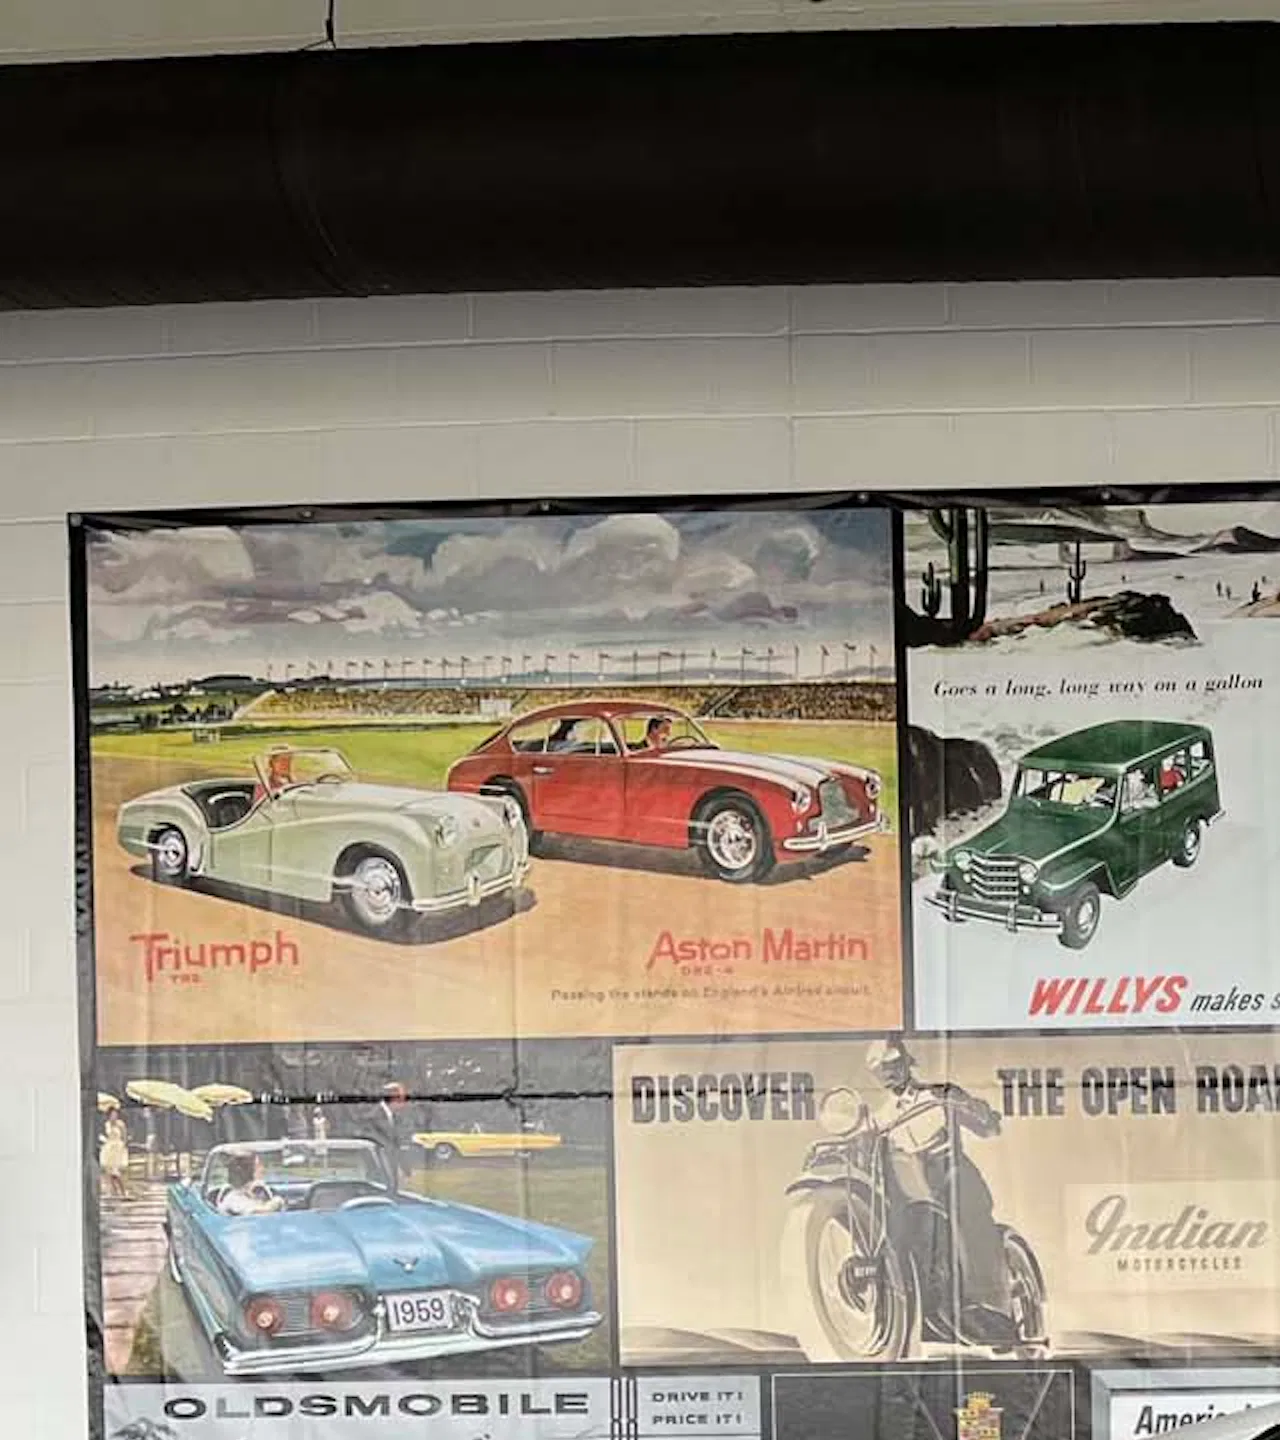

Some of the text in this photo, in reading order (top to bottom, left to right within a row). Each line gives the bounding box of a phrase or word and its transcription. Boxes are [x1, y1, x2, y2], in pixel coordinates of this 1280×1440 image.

[934, 680, 977, 698] Goes
[985, 684, 997, 696] a
[1059, 679, 1100, 698] long
[1154, 681, 1177, 692] on
[1185, 681, 1197, 691] a
[1204, 673, 1264, 692] gallon
[129, 930, 299, 983] Triumph
[645, 927, 869, 970] Aston Martin
[1028, 974, 1188, 1017] WILLYS
[1190, 986, 1263, 1013] makes
[630, 1071, 816, 1124] DISCOVER
[996, 1066, 1065, 1117] THE
[1081, 1065, 1177, 1117] OPEN
[1085, 1194, 1269, 1256] Indian
[1116, 1255, 1242, 1272] MOTORCYCLES
[393, 1297, 445, 1325] 1959
[163, 1392, 590, 1420] OLDSMOBILE
[652, 1391, 709, 1402] DRIVE
[652, 1413, 708, 1425] PRICE
